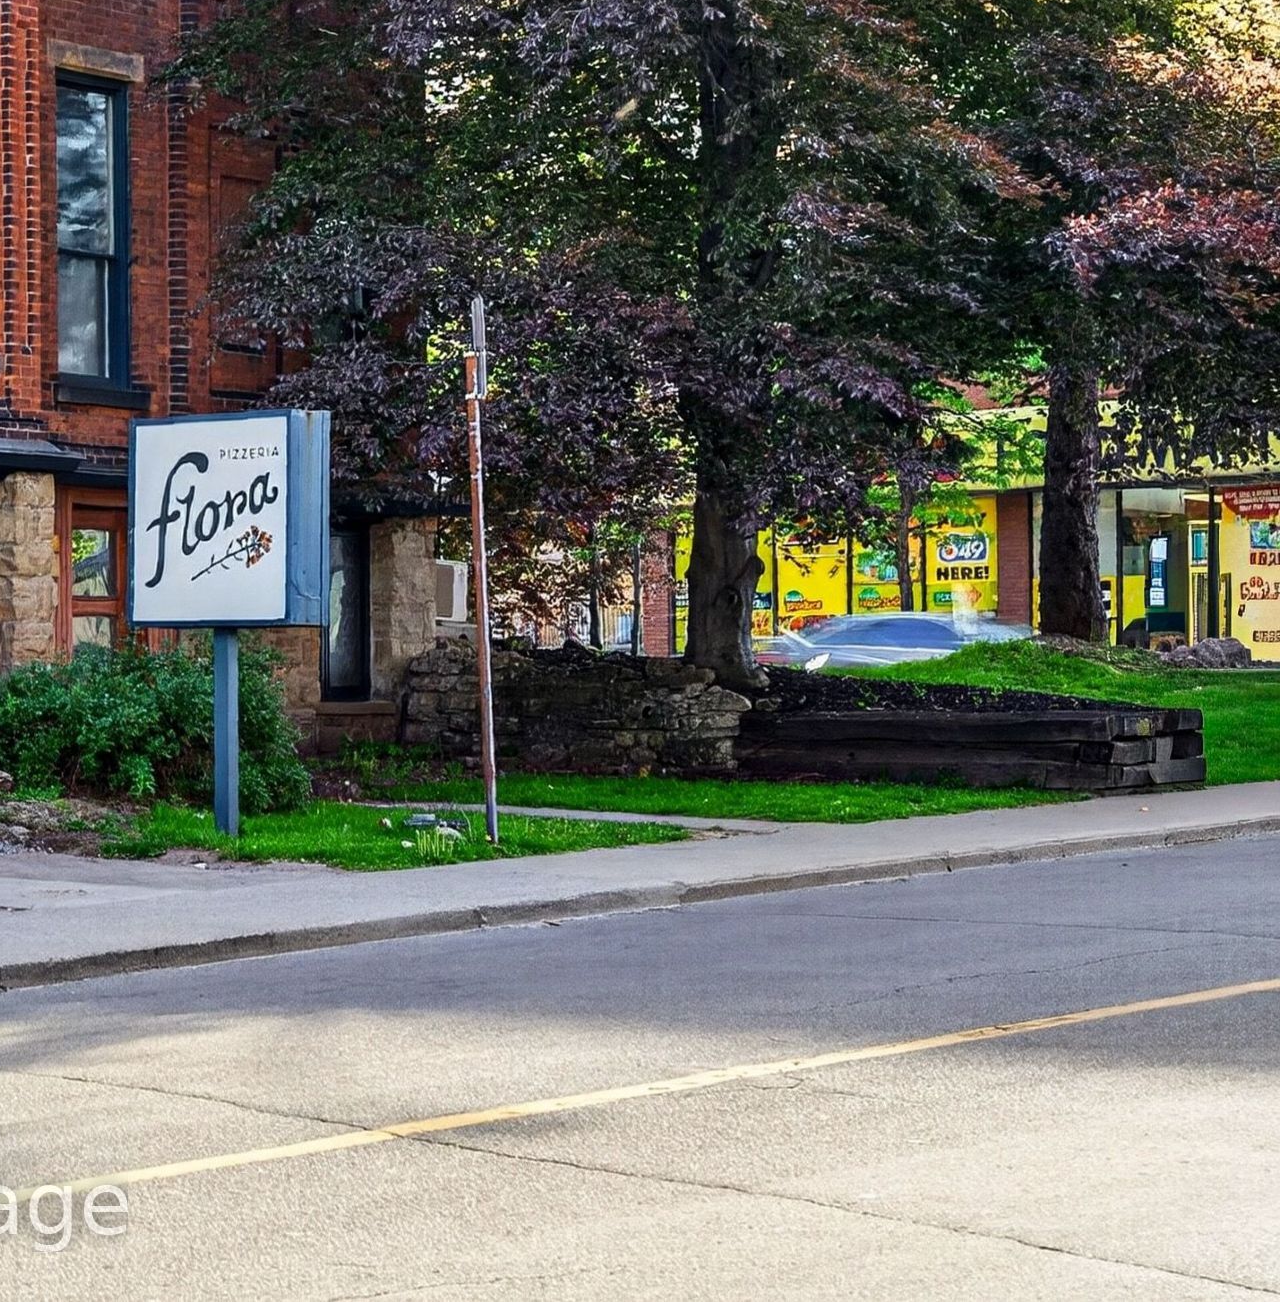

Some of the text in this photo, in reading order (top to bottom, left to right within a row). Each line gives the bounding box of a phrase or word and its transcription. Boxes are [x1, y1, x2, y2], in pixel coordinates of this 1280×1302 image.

[219, 446, 280, 460] PIZZERIA
[145, 451, 279, 588] flora
[936, 565, 990, 581] HERE!
